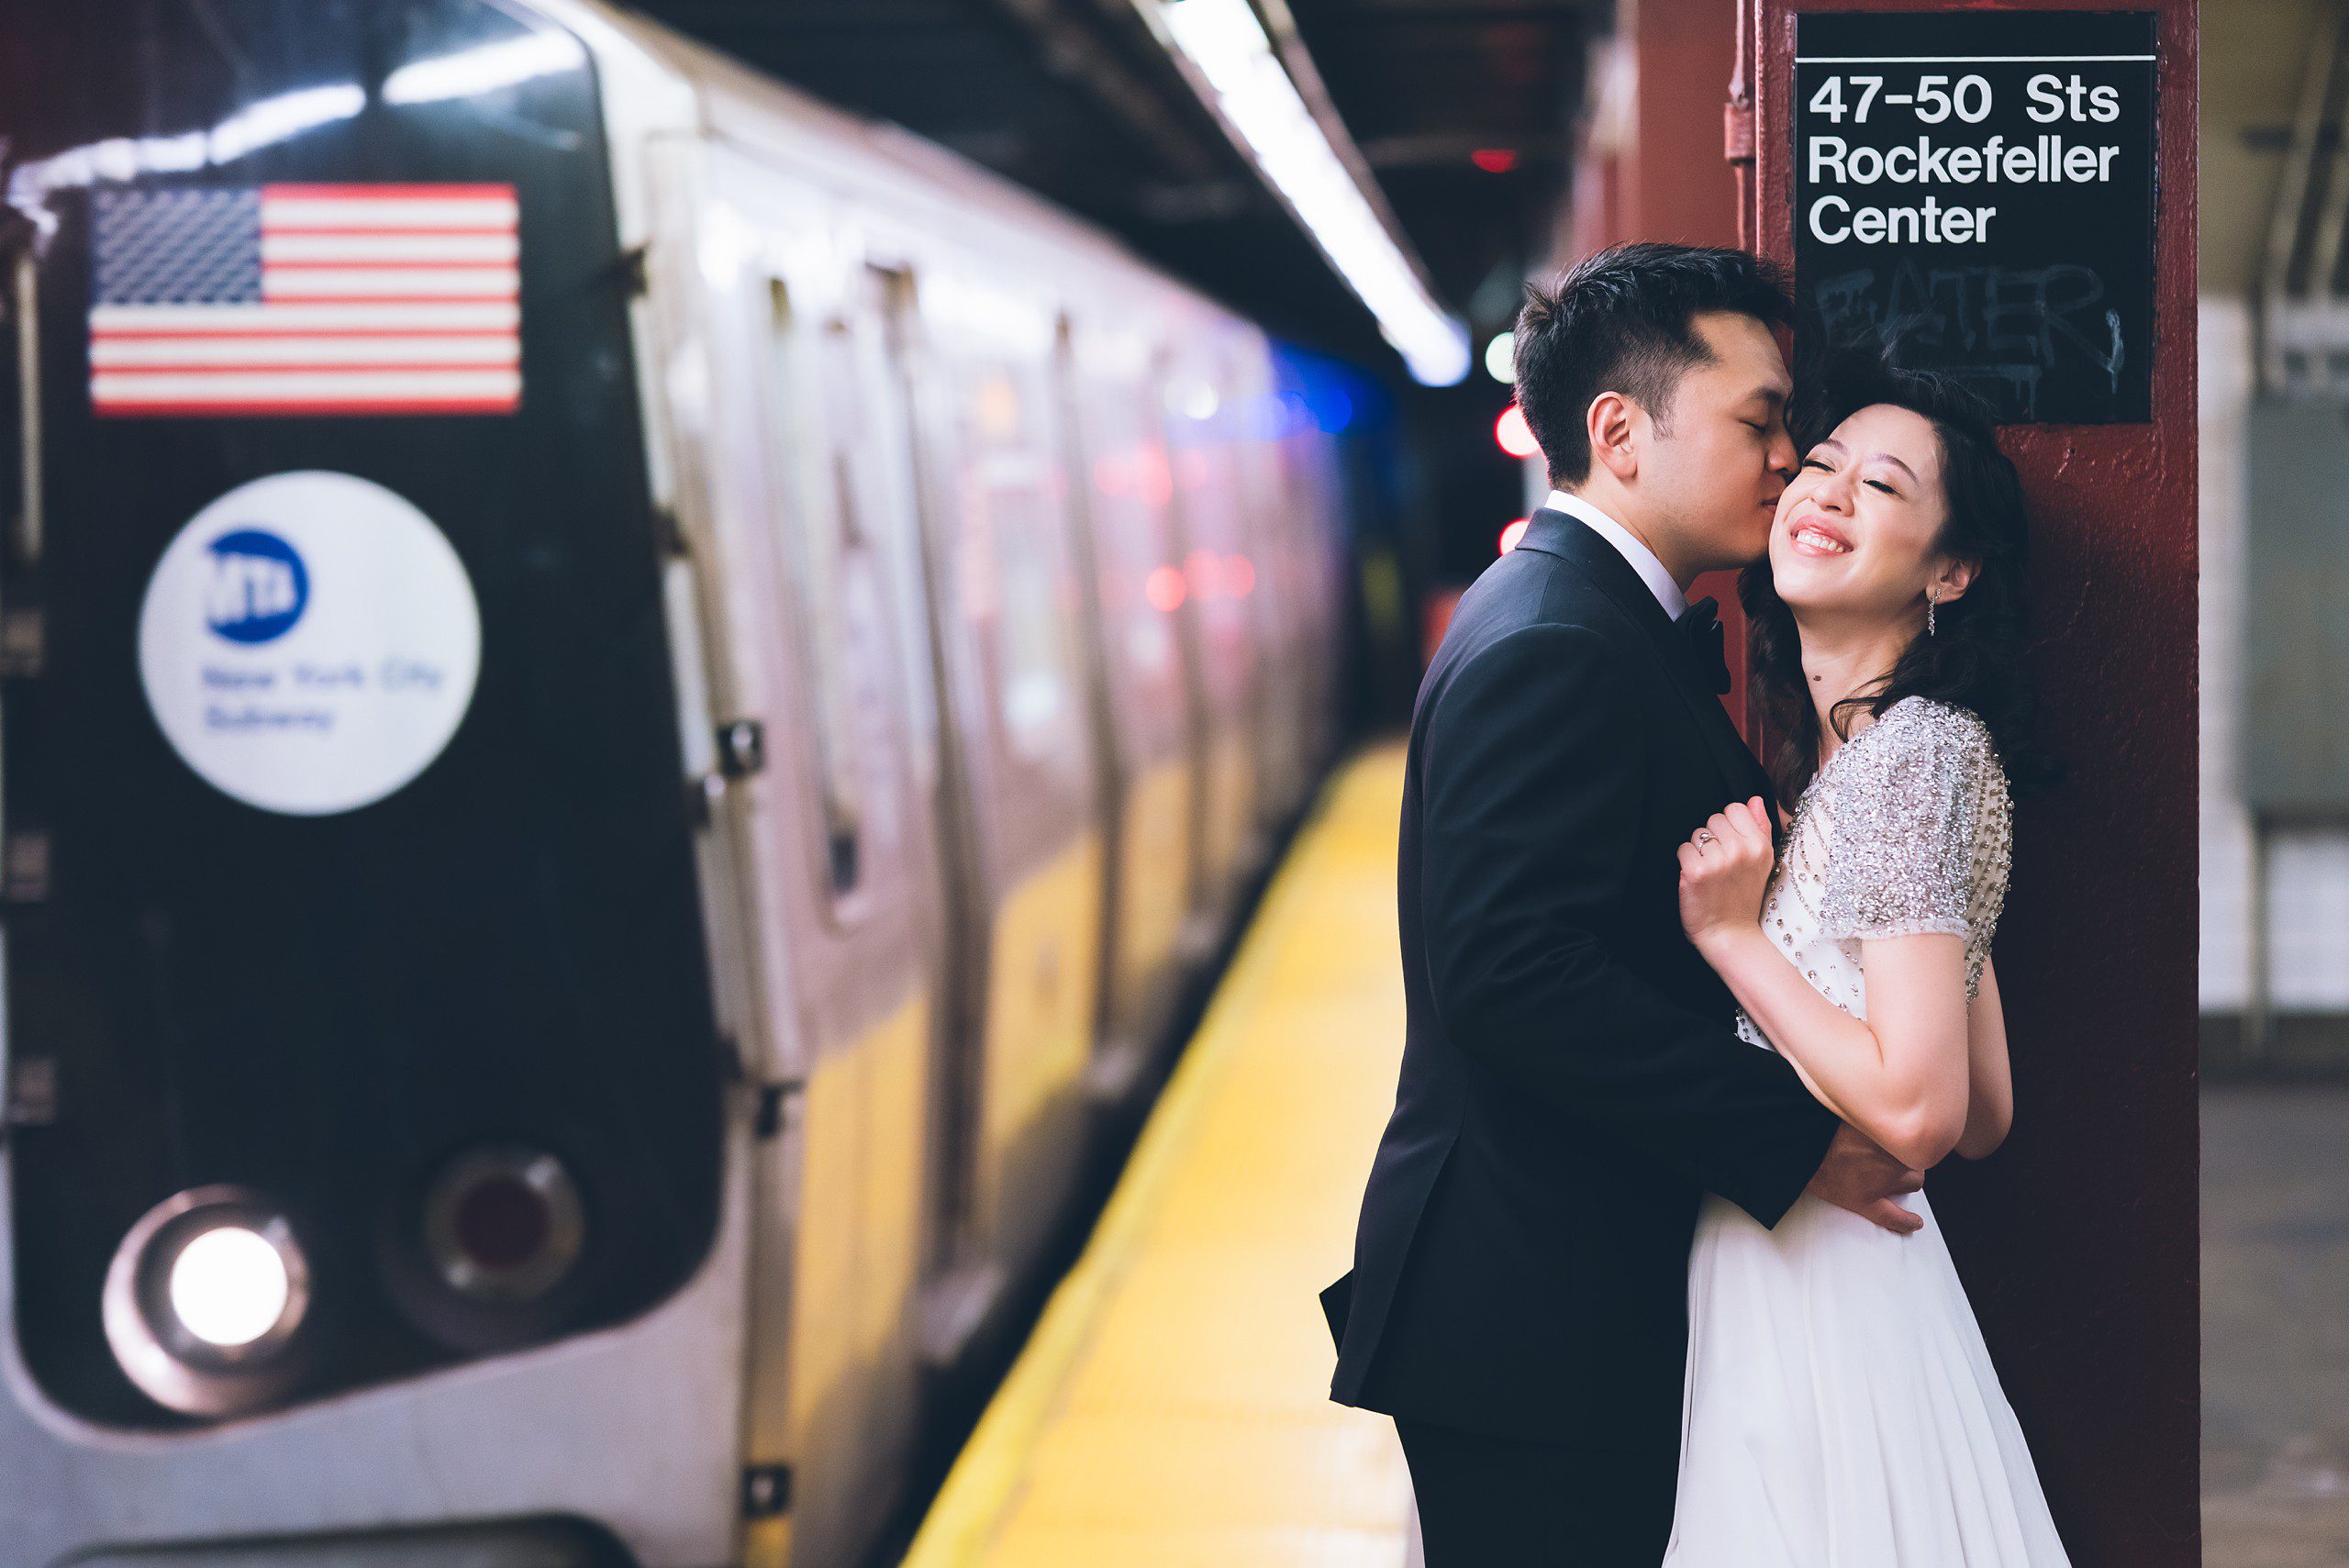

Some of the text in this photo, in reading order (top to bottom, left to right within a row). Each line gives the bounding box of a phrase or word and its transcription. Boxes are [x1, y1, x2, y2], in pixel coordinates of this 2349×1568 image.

[1809, 73, 2121, 124] 47-50 Sts
[1809, 135, 2120, 184] Rockefeller
[1809, 195, 1997, 244] Center
